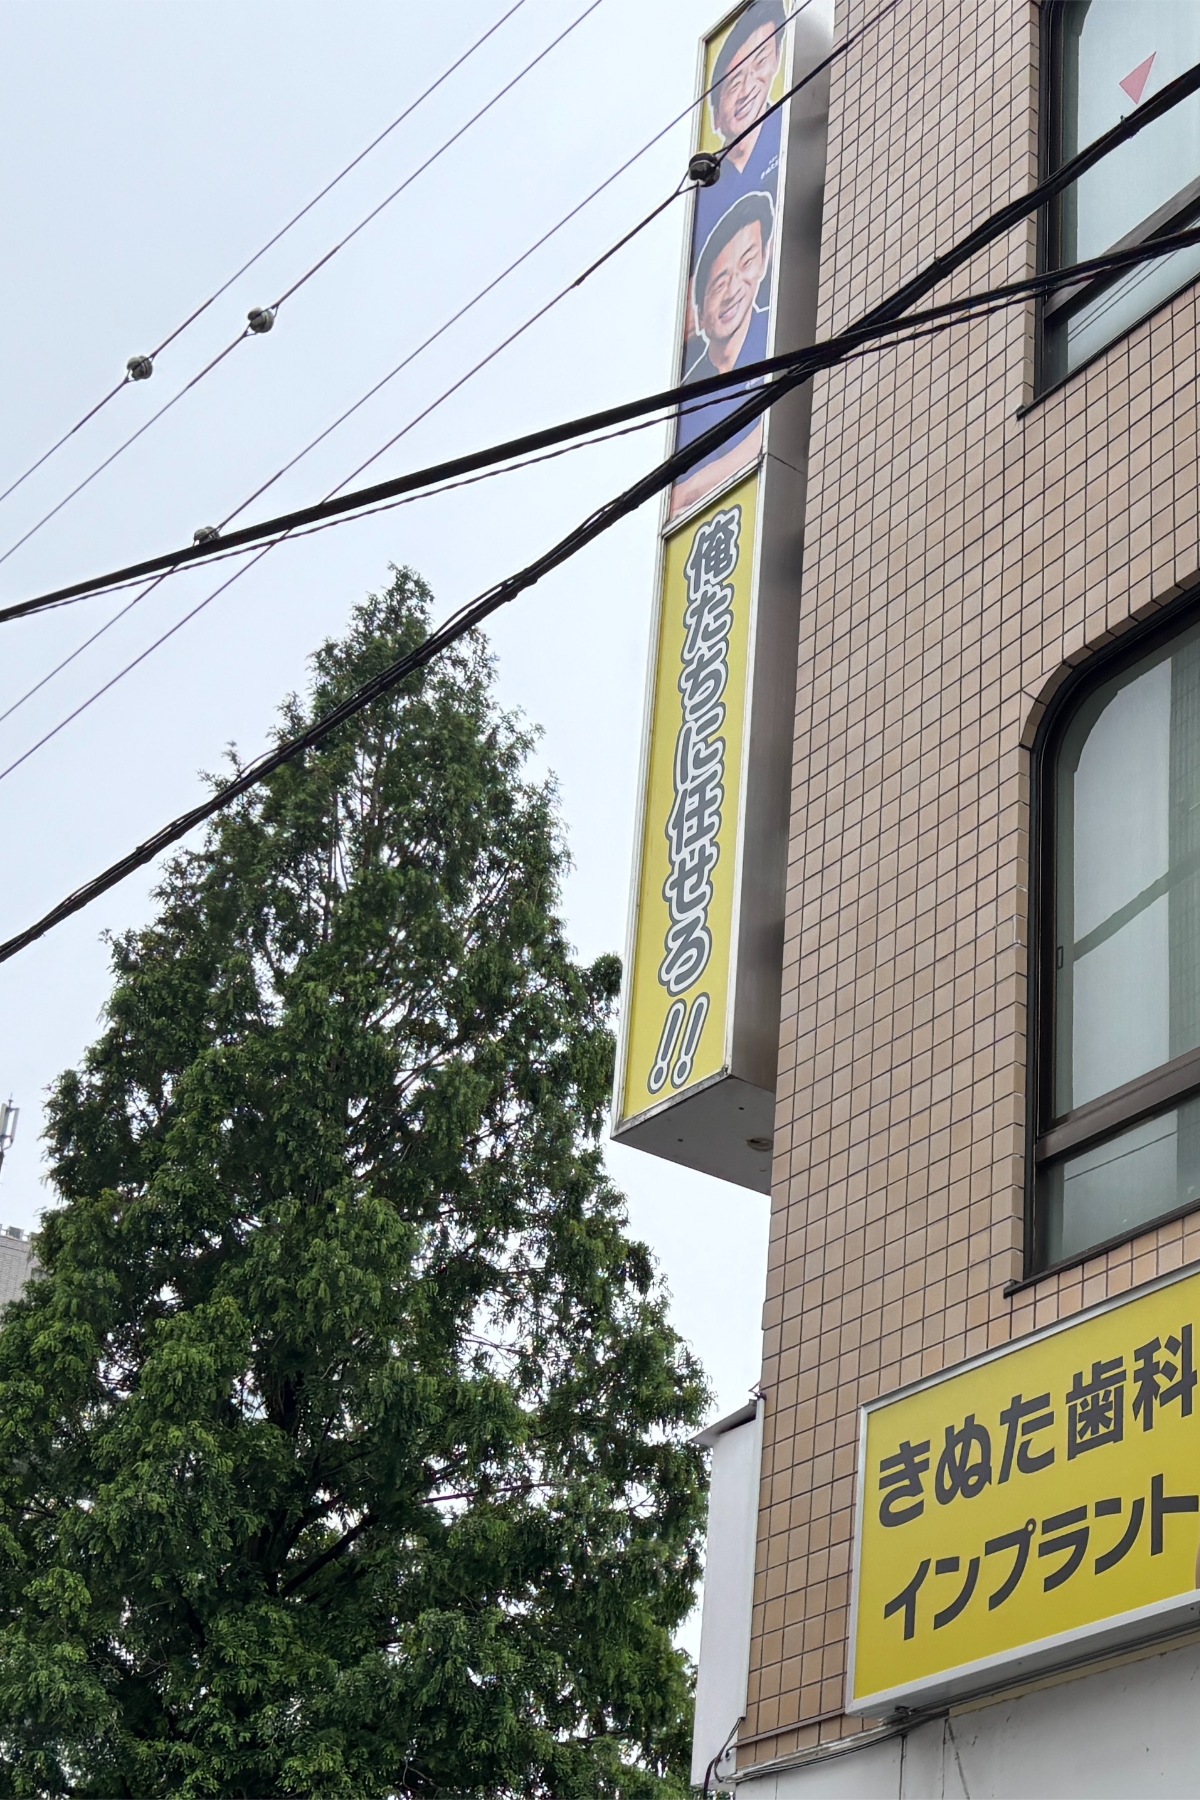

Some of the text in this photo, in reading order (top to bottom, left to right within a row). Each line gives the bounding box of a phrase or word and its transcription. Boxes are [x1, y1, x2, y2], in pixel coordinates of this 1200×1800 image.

[878, 1323, 1198, 1528] きぬた歯科
[884, 1473, 1199, 1641] インプラント
